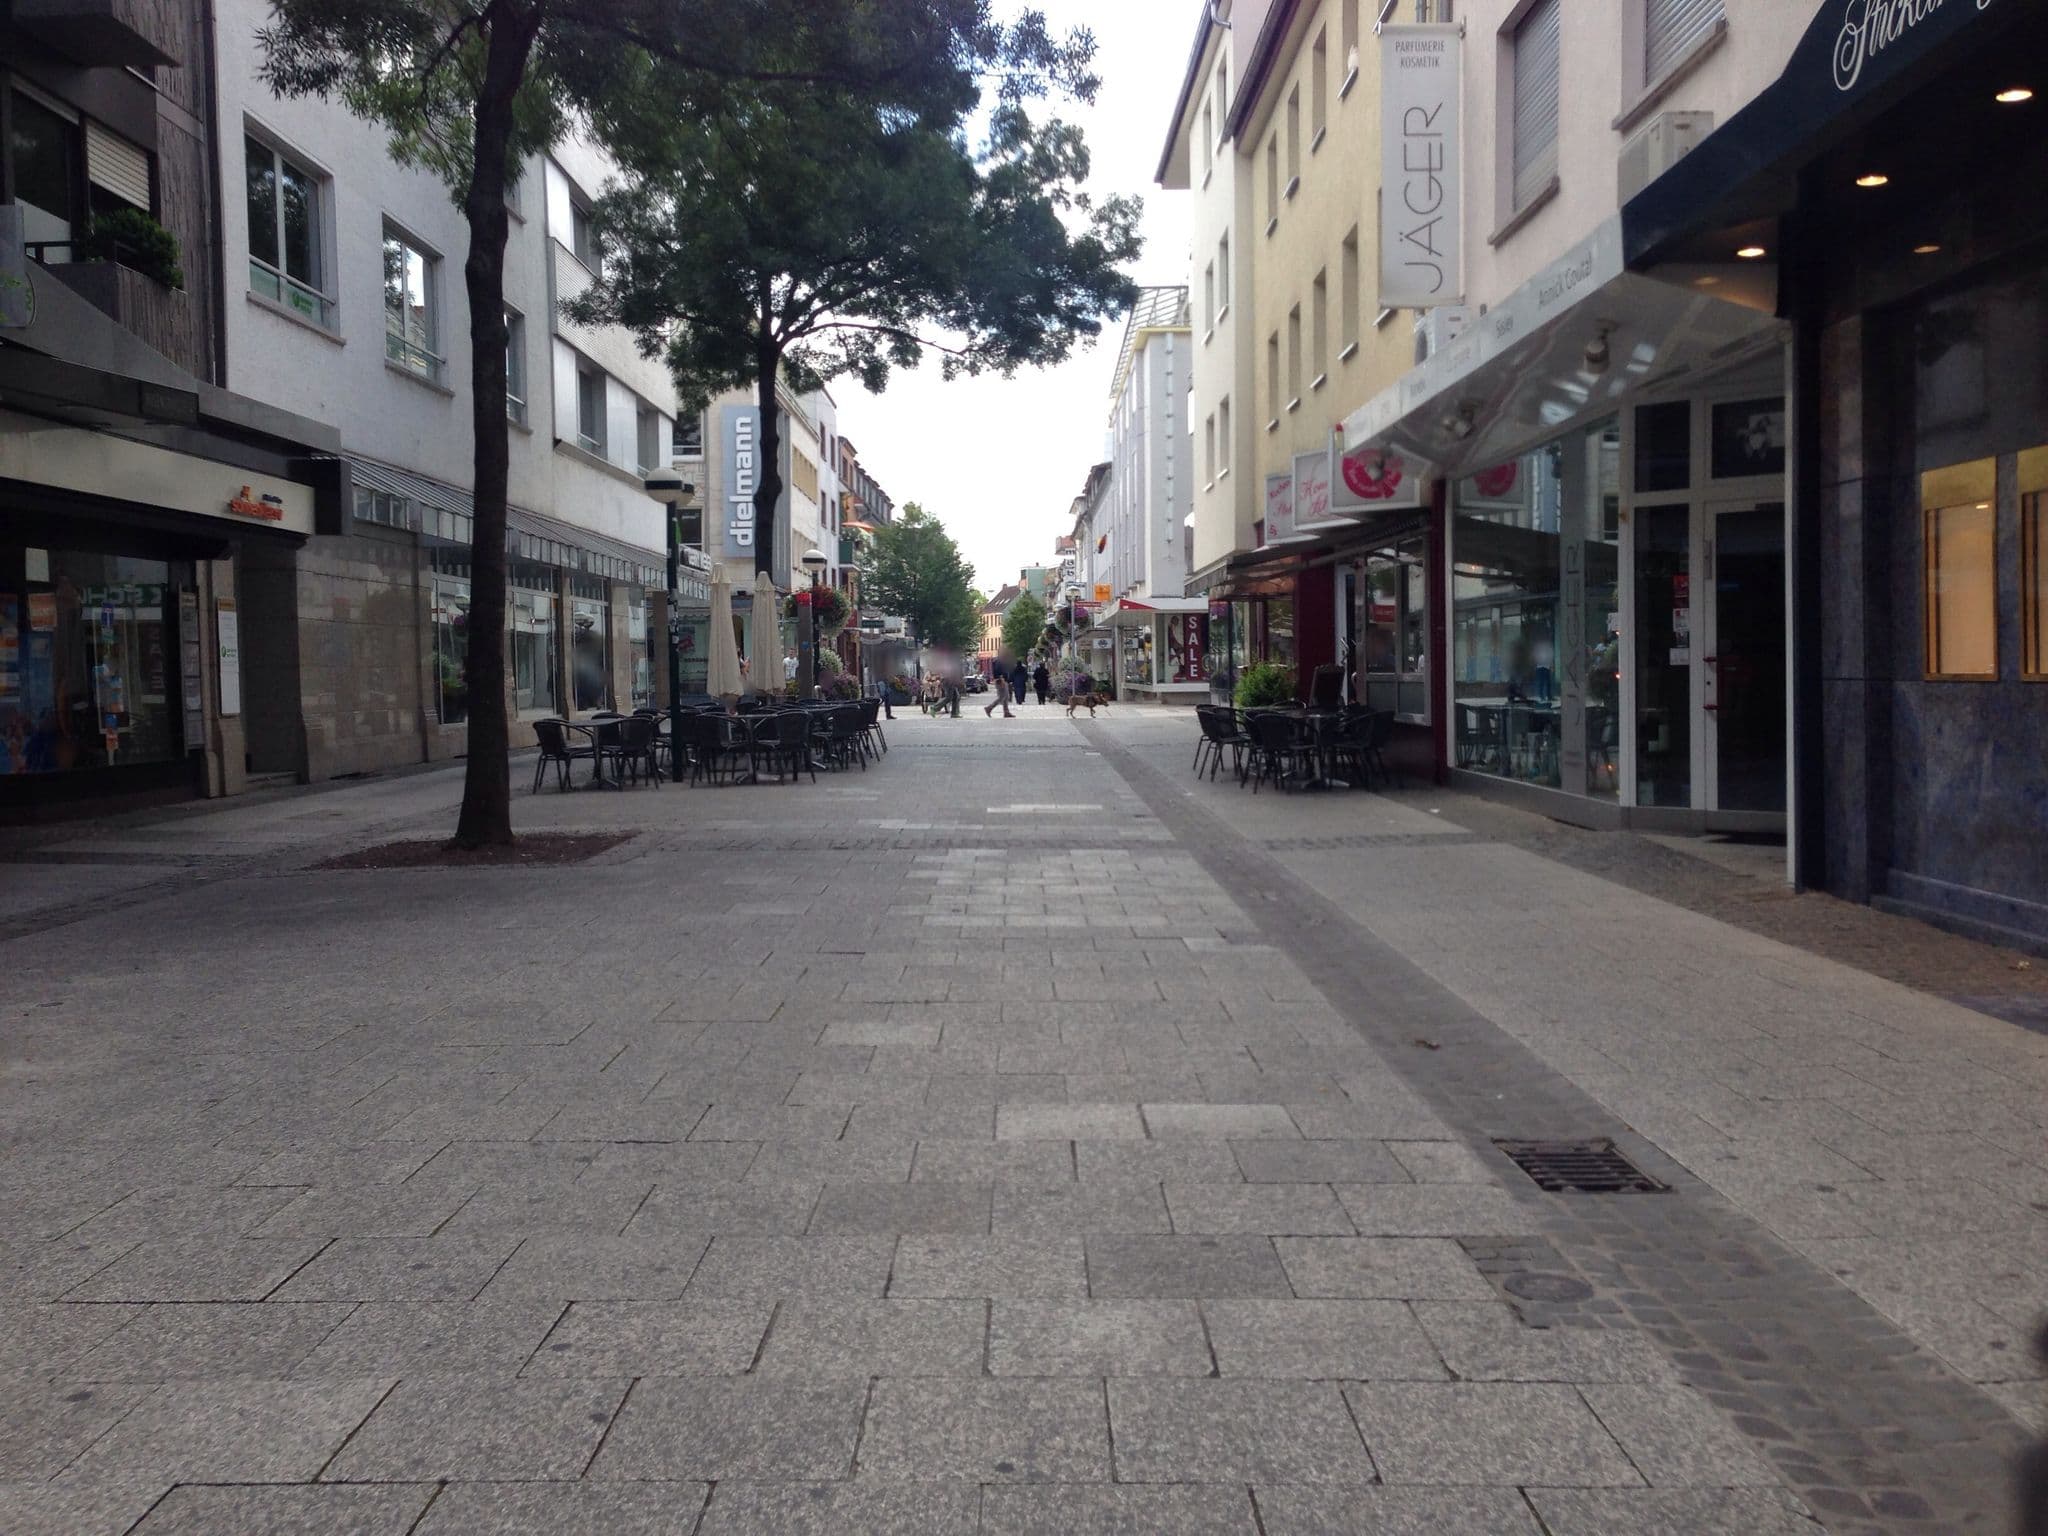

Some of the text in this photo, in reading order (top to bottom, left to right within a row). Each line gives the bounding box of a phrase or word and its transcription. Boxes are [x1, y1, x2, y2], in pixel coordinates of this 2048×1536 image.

[1395, 38, 1445, 53] PARFÜMERIE
[1400, 55, 1440, 69] KOSMETIK
[1399, 102, 1443, 293] JÄGER
[729, 415, 753, 547] dielmann
[1188, 616, 1199, 677] SALE
